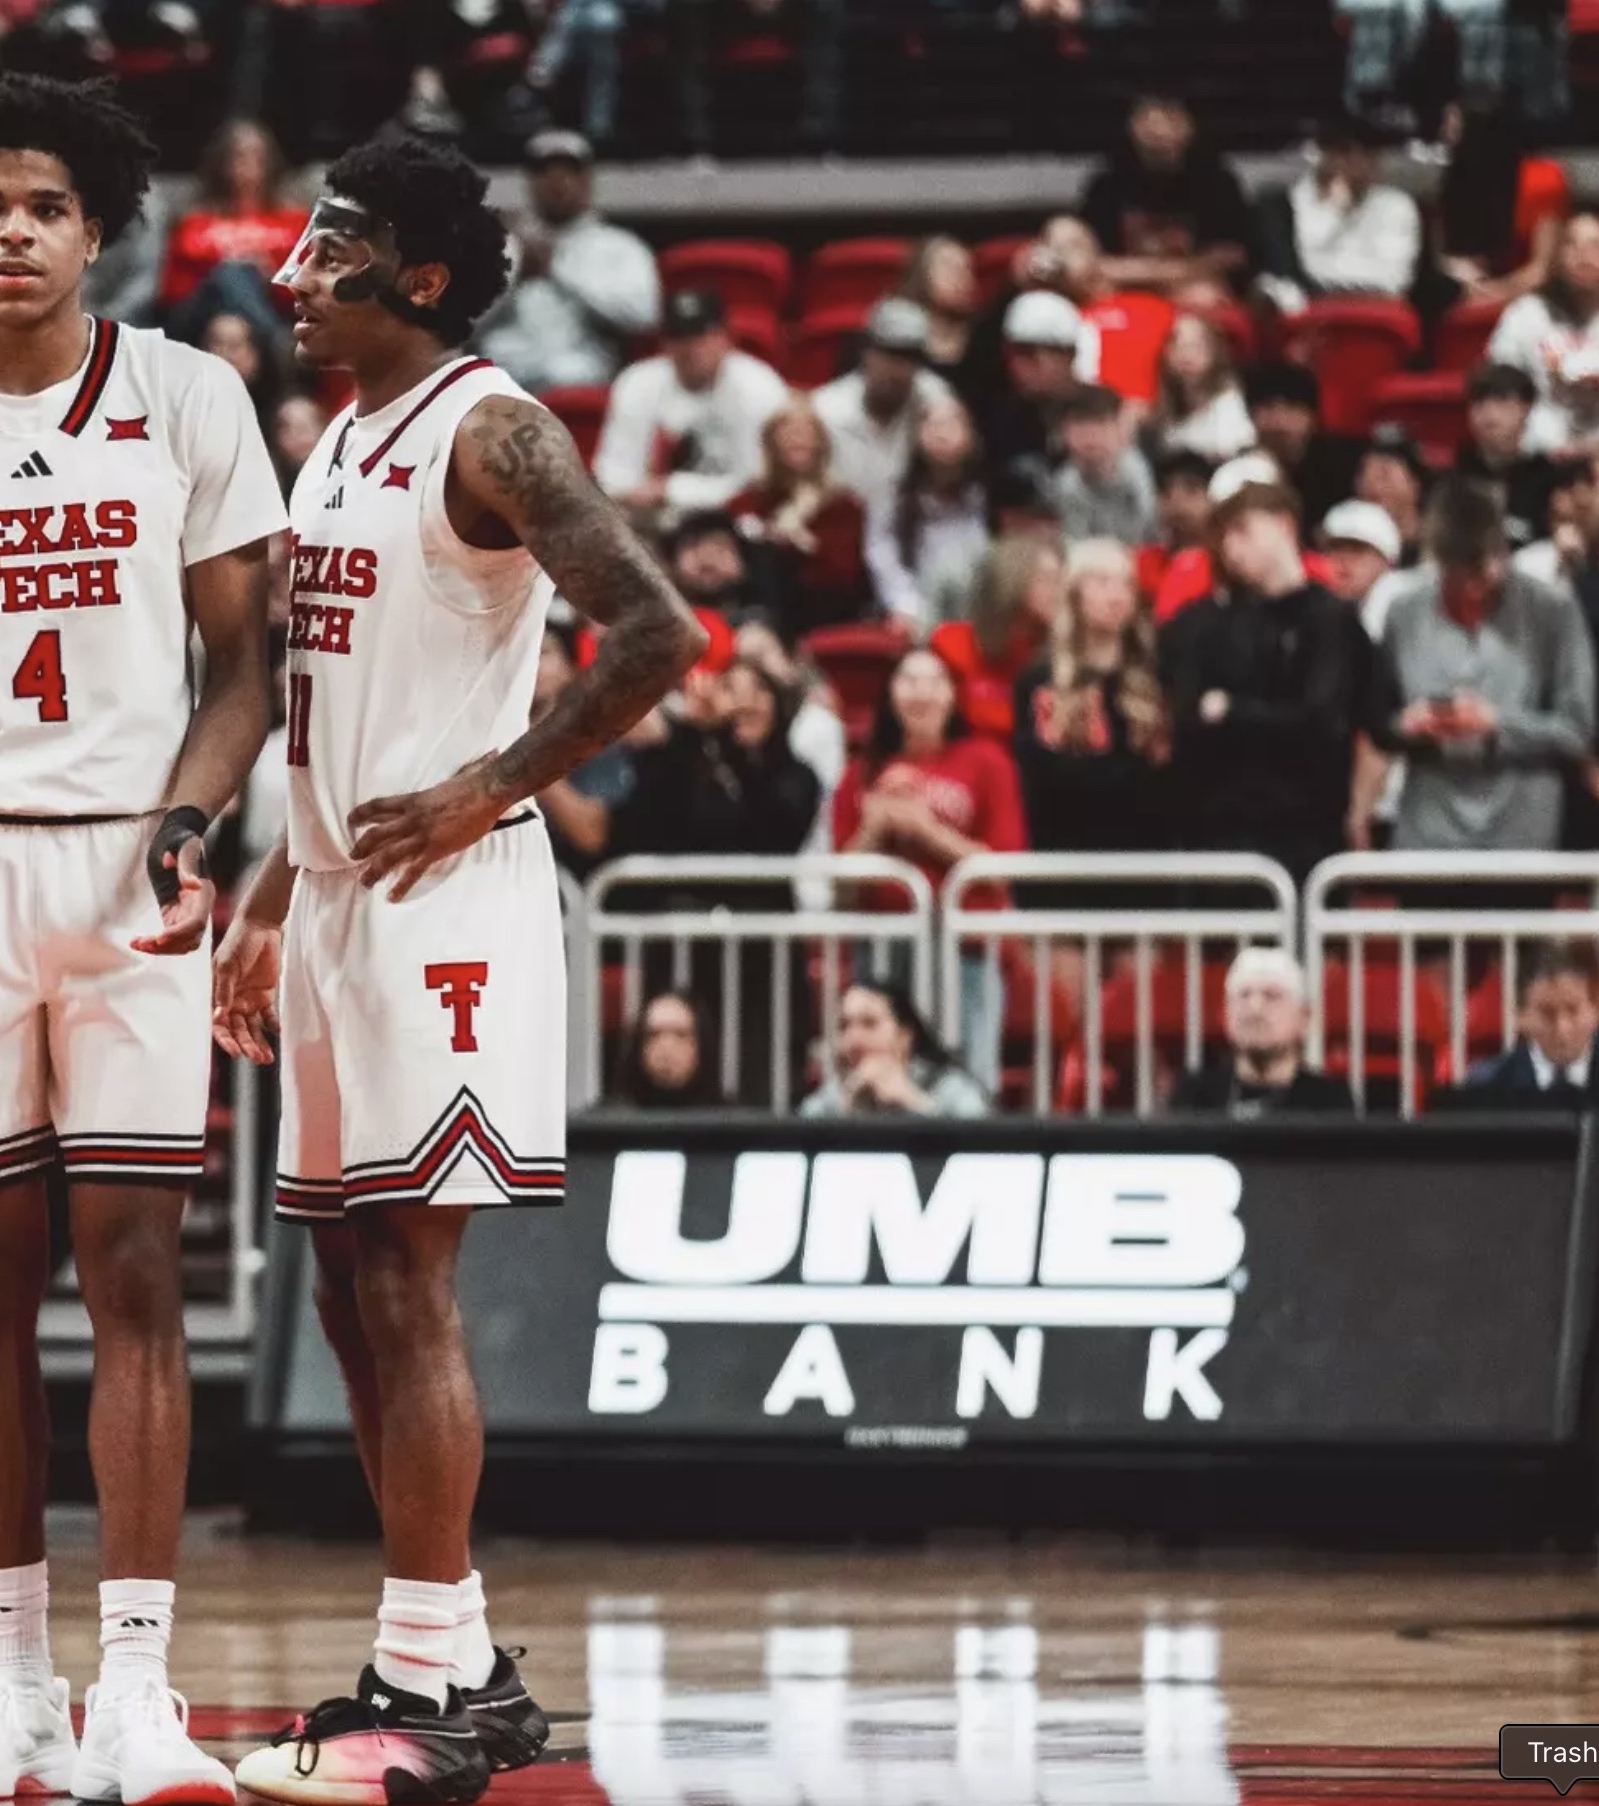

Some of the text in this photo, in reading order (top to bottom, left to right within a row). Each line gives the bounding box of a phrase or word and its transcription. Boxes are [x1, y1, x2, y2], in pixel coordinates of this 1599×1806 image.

[12, 629, 69, 723] 4
[287, 602, 355, 655] ECH
[606, 1150, 1246, 1287] UMB
[587, 1322, 1229, 1422] BANK
